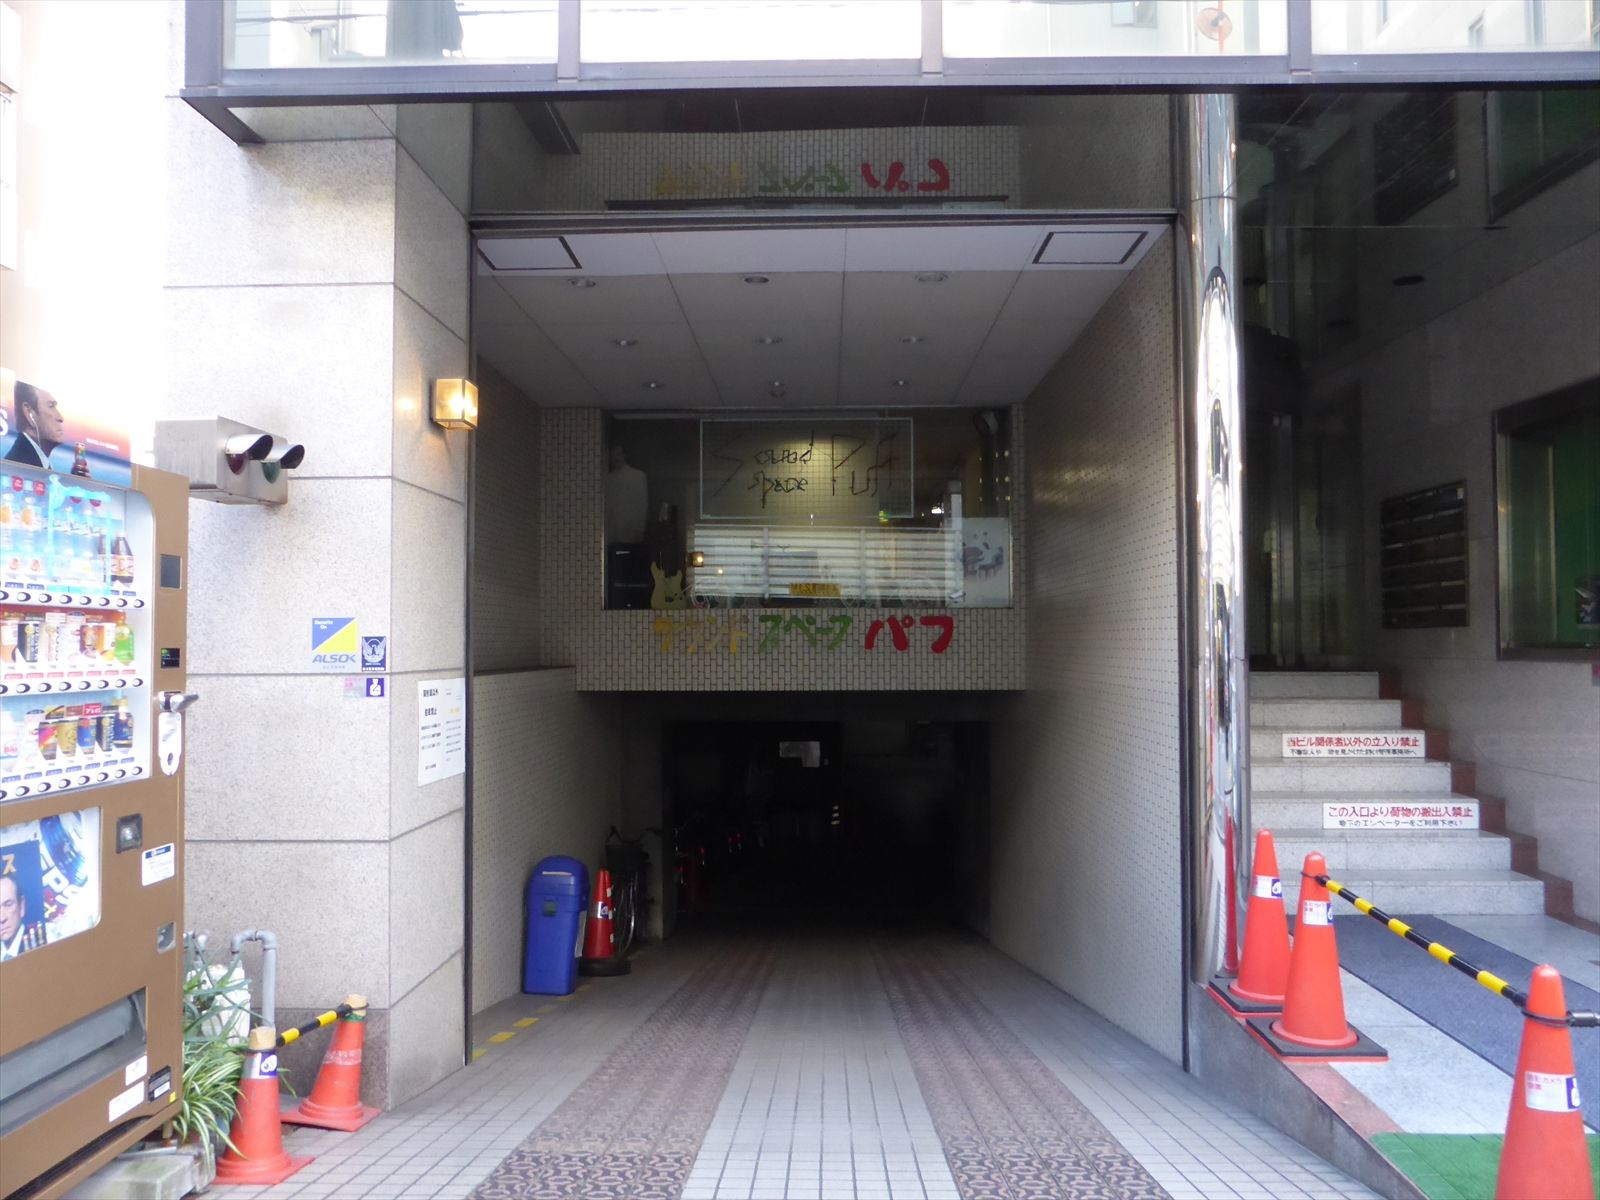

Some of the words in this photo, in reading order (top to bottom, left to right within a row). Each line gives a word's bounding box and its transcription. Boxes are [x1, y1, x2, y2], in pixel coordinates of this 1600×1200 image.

[864, 615, 954, 654] パフ
[312, 654, 357, 664] ALSOK
[1287, 736, 1420, 748] 当ビル関係者以外の立入り禁止
[1328, 805, 1473, 818] この入口より荷物の搬出入禁止
